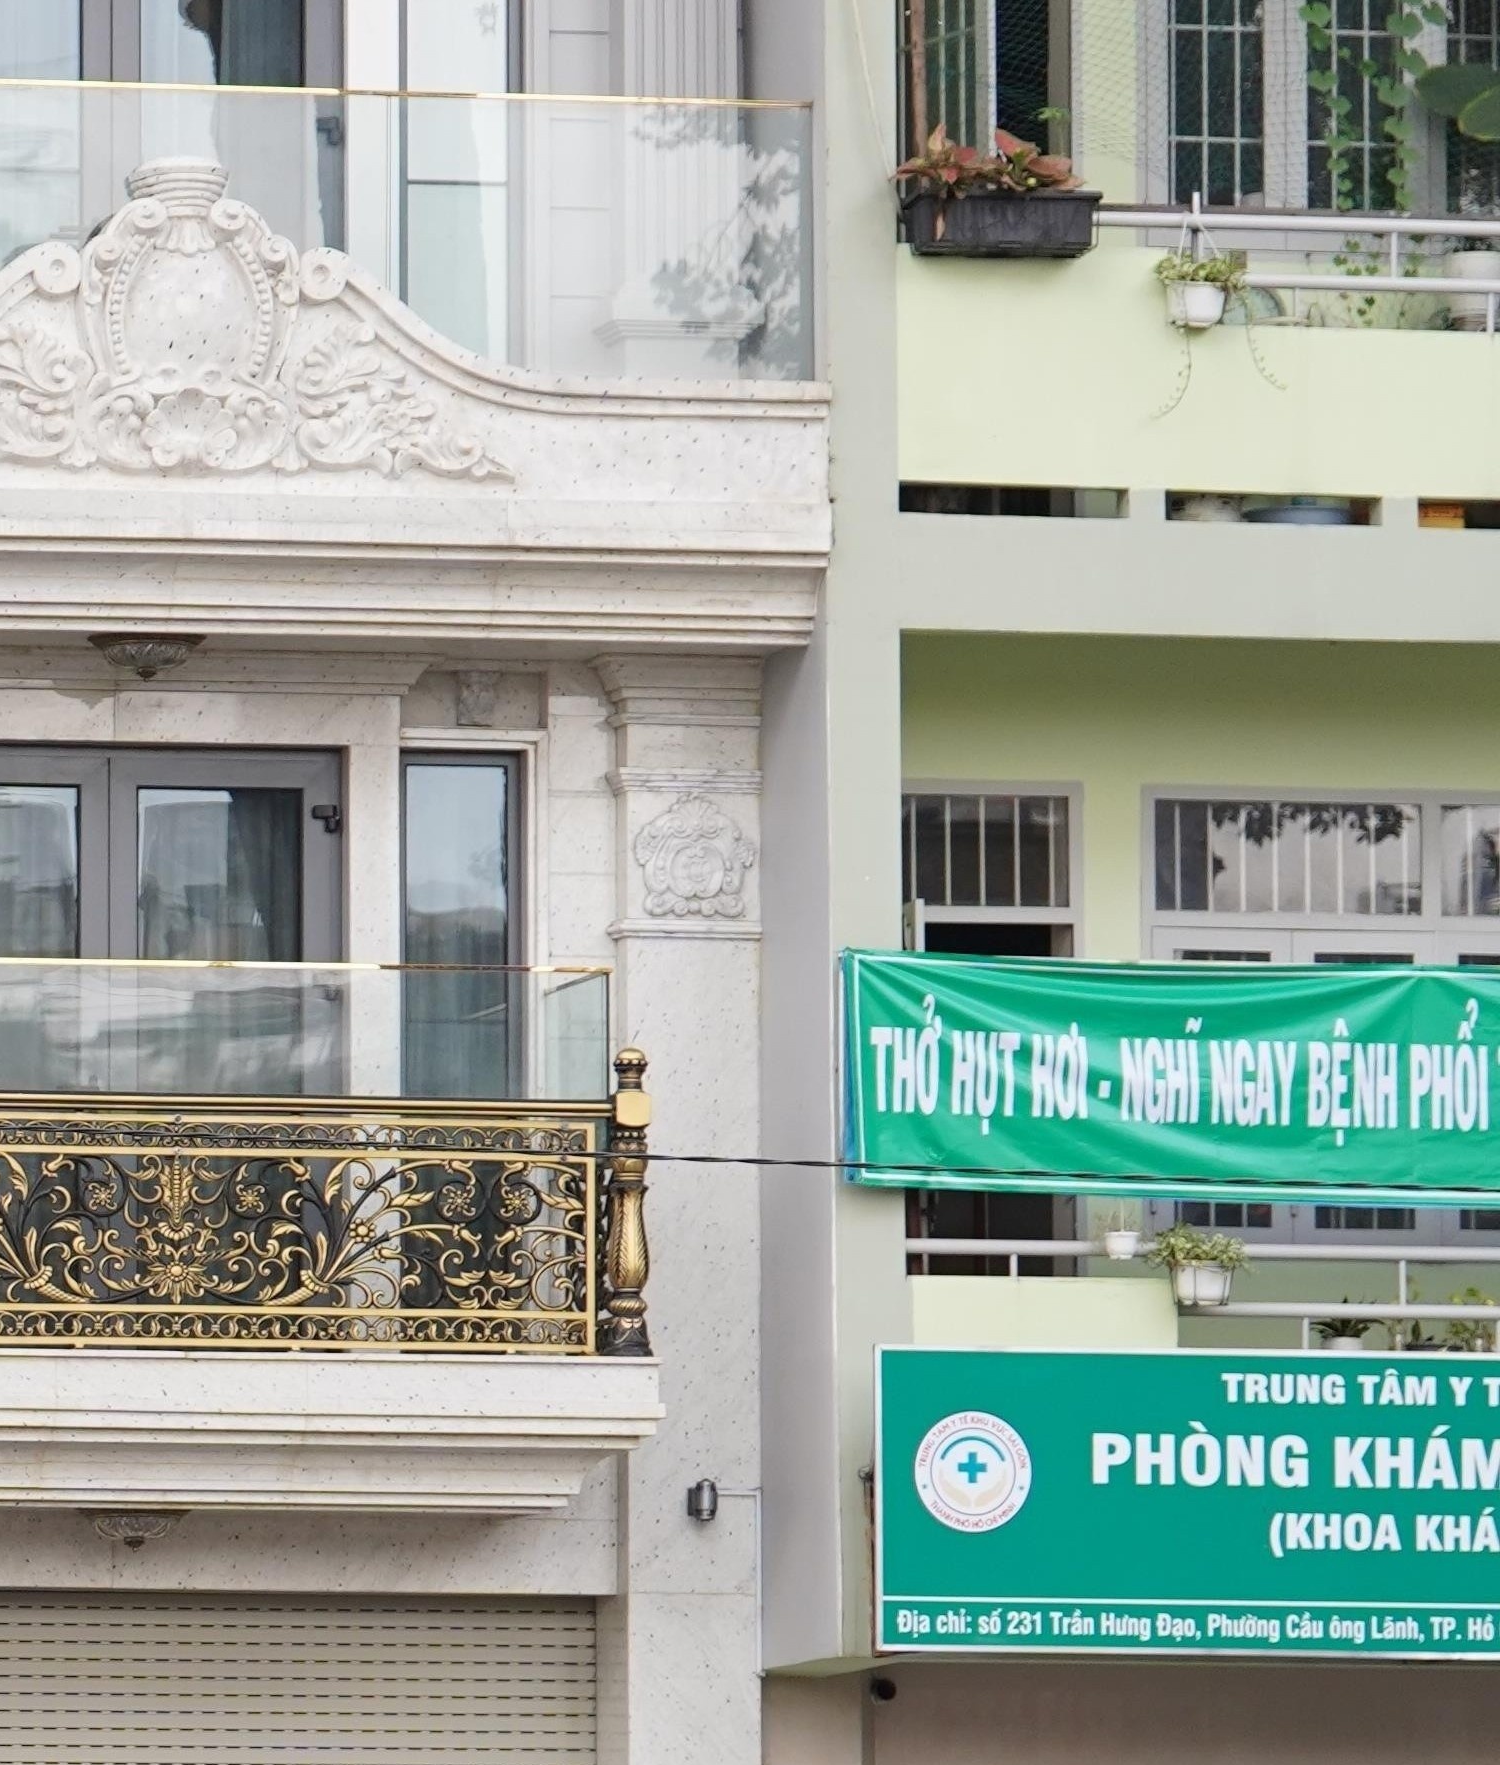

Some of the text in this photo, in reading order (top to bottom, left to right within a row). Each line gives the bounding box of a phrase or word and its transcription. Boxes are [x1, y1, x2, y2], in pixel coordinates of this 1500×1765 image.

[869, 993, 943, 1115] THỞ
[950, 1029, 1020, 1135] HỤT
[1030, 1021, 1089, 1121] HƠI
[1209, 1037, 1298, 1127] NGAY
[1306, 1017, 1400, 1147] BỆNH
[1408, 998, 1490, 1132] PHỔI
[1220, 1372, 1347, 1405] TRUNG
[1357, 1367, 1438, 1406] TÂM
[1448, 1376, 1474, 1407] Y
[1091, 1420, 1500, 1490] PHÒNG KHÁM
[1269, 1512, 1402, 1558] (KHOA
[897, 1607, 931, 1635] Địa
[979, 1606, 1002, 1634] số
[1006, 1611, 1042, 1634] 231
[1049, 1607, 1095, 1636] Trần
[1101, 1610, 1151, 1641] Hưng
[1156, 1610, 1201, 1640] Đạo,
[1207, 1608, 1280, 1645] Phường
[1286, 1611, 1324, 1639] Cầu
[1329, 1615, 1366, 1644] ông
[1370, 1615, 1425, 1643] Lãnh,
[1429, 1616, 1462, 1641] TP.
[1467, 1614, 1495, 1641] Hồ
